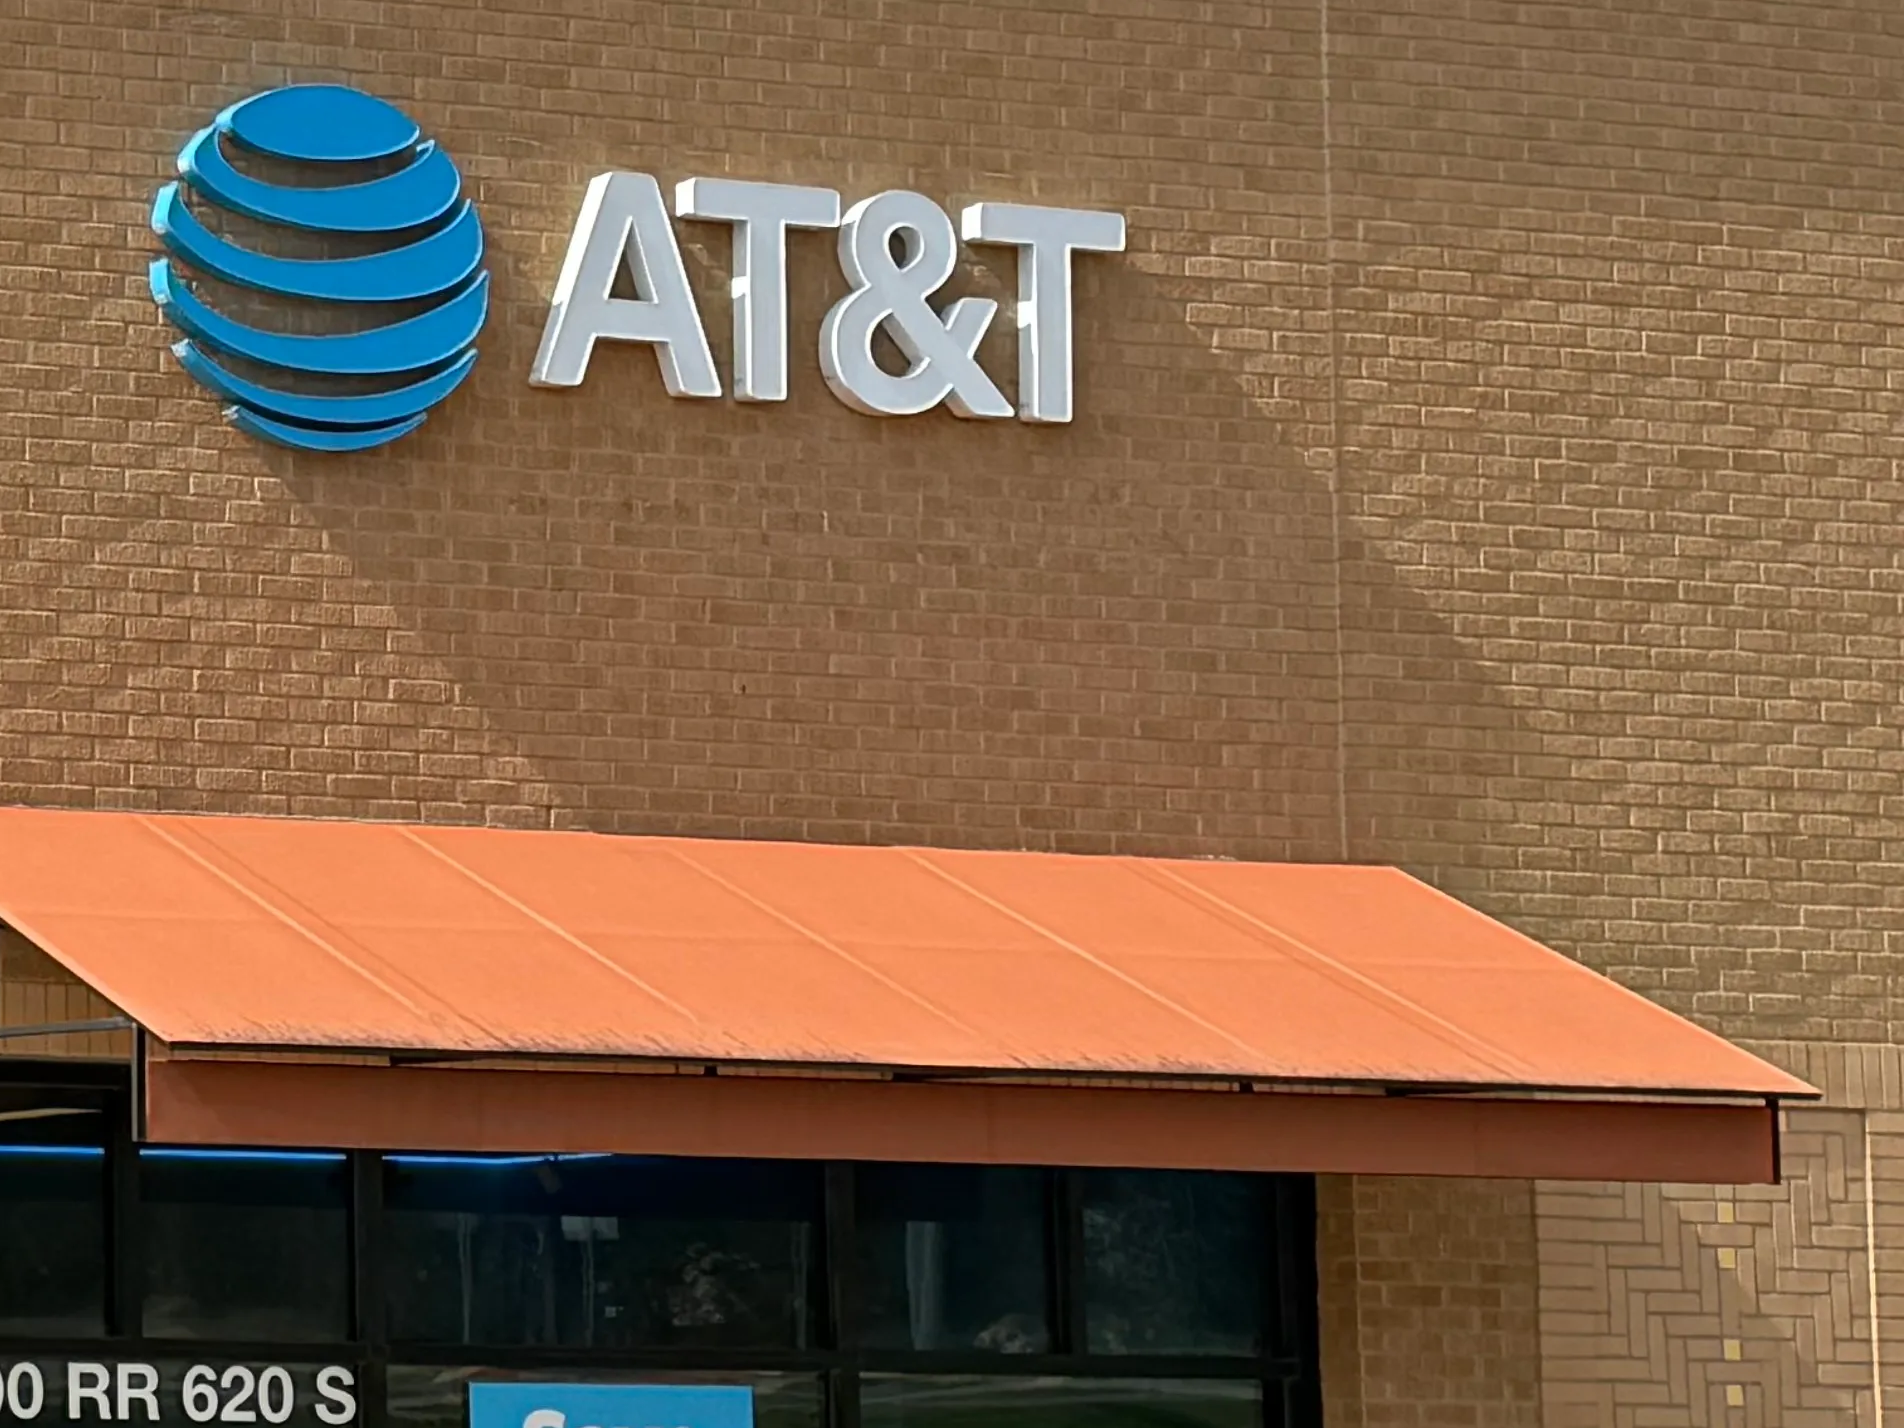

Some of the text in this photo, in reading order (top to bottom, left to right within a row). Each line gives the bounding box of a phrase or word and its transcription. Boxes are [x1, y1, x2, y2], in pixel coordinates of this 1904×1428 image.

[528, 172, 1126, 423] AT&T
[67, 1362, 161, 1421] RR
[182, 1364, 295, 1424] 620
[314, 1366, 357, 1425] S
